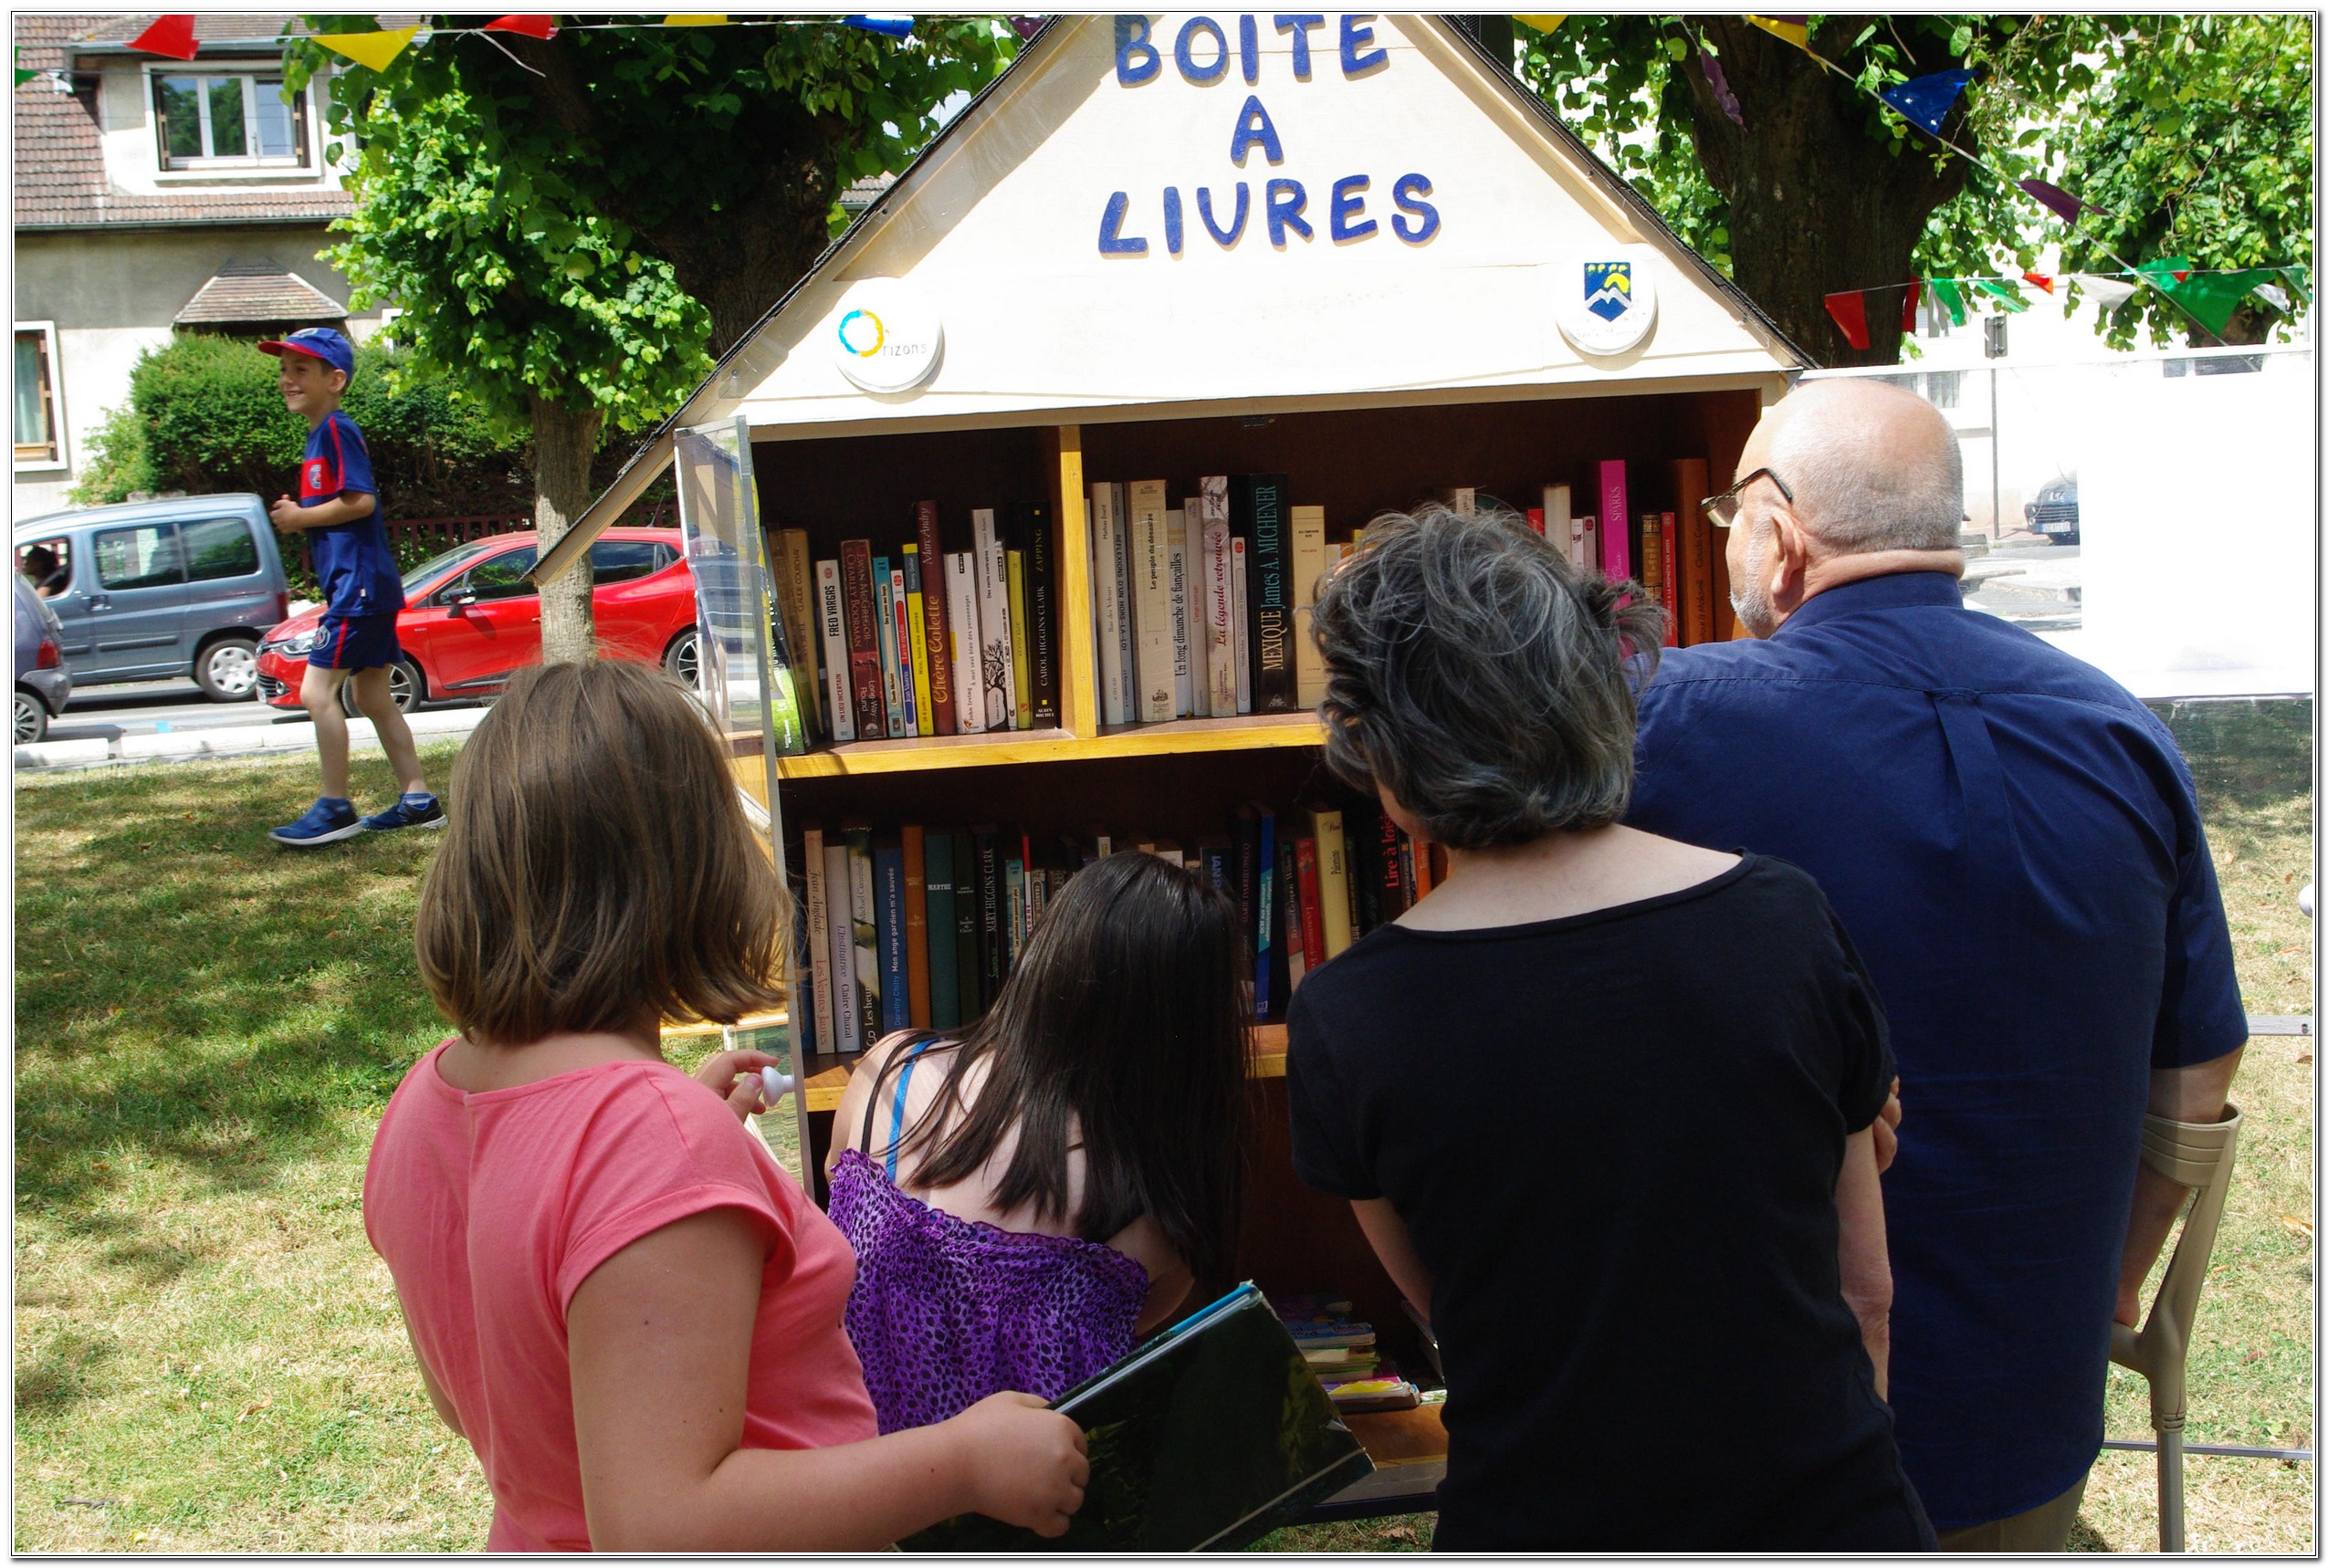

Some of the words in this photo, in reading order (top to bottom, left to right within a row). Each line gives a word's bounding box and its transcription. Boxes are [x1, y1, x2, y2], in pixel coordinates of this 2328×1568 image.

[1115, 14, 1388, 84] BOITE
[1231, 95, 1283, 163] A
[1098, 172, 1440, 255] LIVRES
[1610, 486, 1622, 521] SPARKS
[919, 507, 932, 538] Andry
[1147, 513, 1155, 544] désastre
[1254, 486, 1278, 555] MICHENER
[921, 539, 934, 564] Marc
[1035, 529, 1044, 572] ZAPPING
[1148, 545, 1156, 553] du
[1212, 531, 1223, 582] retrouvée
[1258, 557, 1280, 570] A.
[1694, 540, 1704, 568] Claude
[792, 548, 803, 585] COURCHAY
[845, 553, 858, 598] CHARLEY
[1149, 555, 1158, 579] peuple
[1170, 553, 1185, 592] fiançailles
[795, 586, 804, 612] CLAUDE
[824, 585, 838, 615] VARGAS
[1036, 585, 1045, 615] CLARK
[1150, 580, 1158, 590] Le
[1172, 595, 1183, 604] de
[1260, 573, 1285, 609] James
[964, 595, 973, 630] personnages
[1213, 586, 1227, 626] légende
[829, 617, 840, 637] FRED
[851, 599, 863, 647] BOORMAN
[928, 595, 944, 653] Colette
[1037, 616, 1048, 654] HIGGINS
[1173, 604, 1186, 643] dimanche
[1214, 631, 1227, 646] La
[1260, 610, 1287, 671] MEXIQUE
[1174, 645, 1188, 663] long
[929, 653, 949, 704] Chère
[1038, 656, 1048, 686] CAROL
[1174, 664, 1187, 676] Un
[835, 674, 844, 702] INCERTAIN
[860, 686, 868, 712] Round
[868, 680, 876, 700] Long
[840, 714, 845, 723] UN
[869, 701, 878, 716] Way
[982, 848, 994, 873] CLARK
[1331, 851, 1341, 874] Palomino
[1383, 847, 1398, 856] à
[809, 870, 821, 893] Jean
[1384, 860, 1400, 887] Lire
[984, 876, 995, 909] HIGGINS
[812, 896, 824, 935] Anglade
[858, 894, 867, 922] Michael
[889, 909, 897, 936] gardien
[986, 911, 997, 932] MARY
[836, 925, 847, 977] L'Institutrice
[816, 960, 826, 977] Les
[817, 978, 828, 1011] Ventres
[841, 984, 850, 1008] Claire
[844, 1009, 853, 1039] Chazal
[865, 1010, 874, 1026] Les
[894, 998, 902, 1026] Dorothy
[816, 1015, 829, 1046] Jaunes
